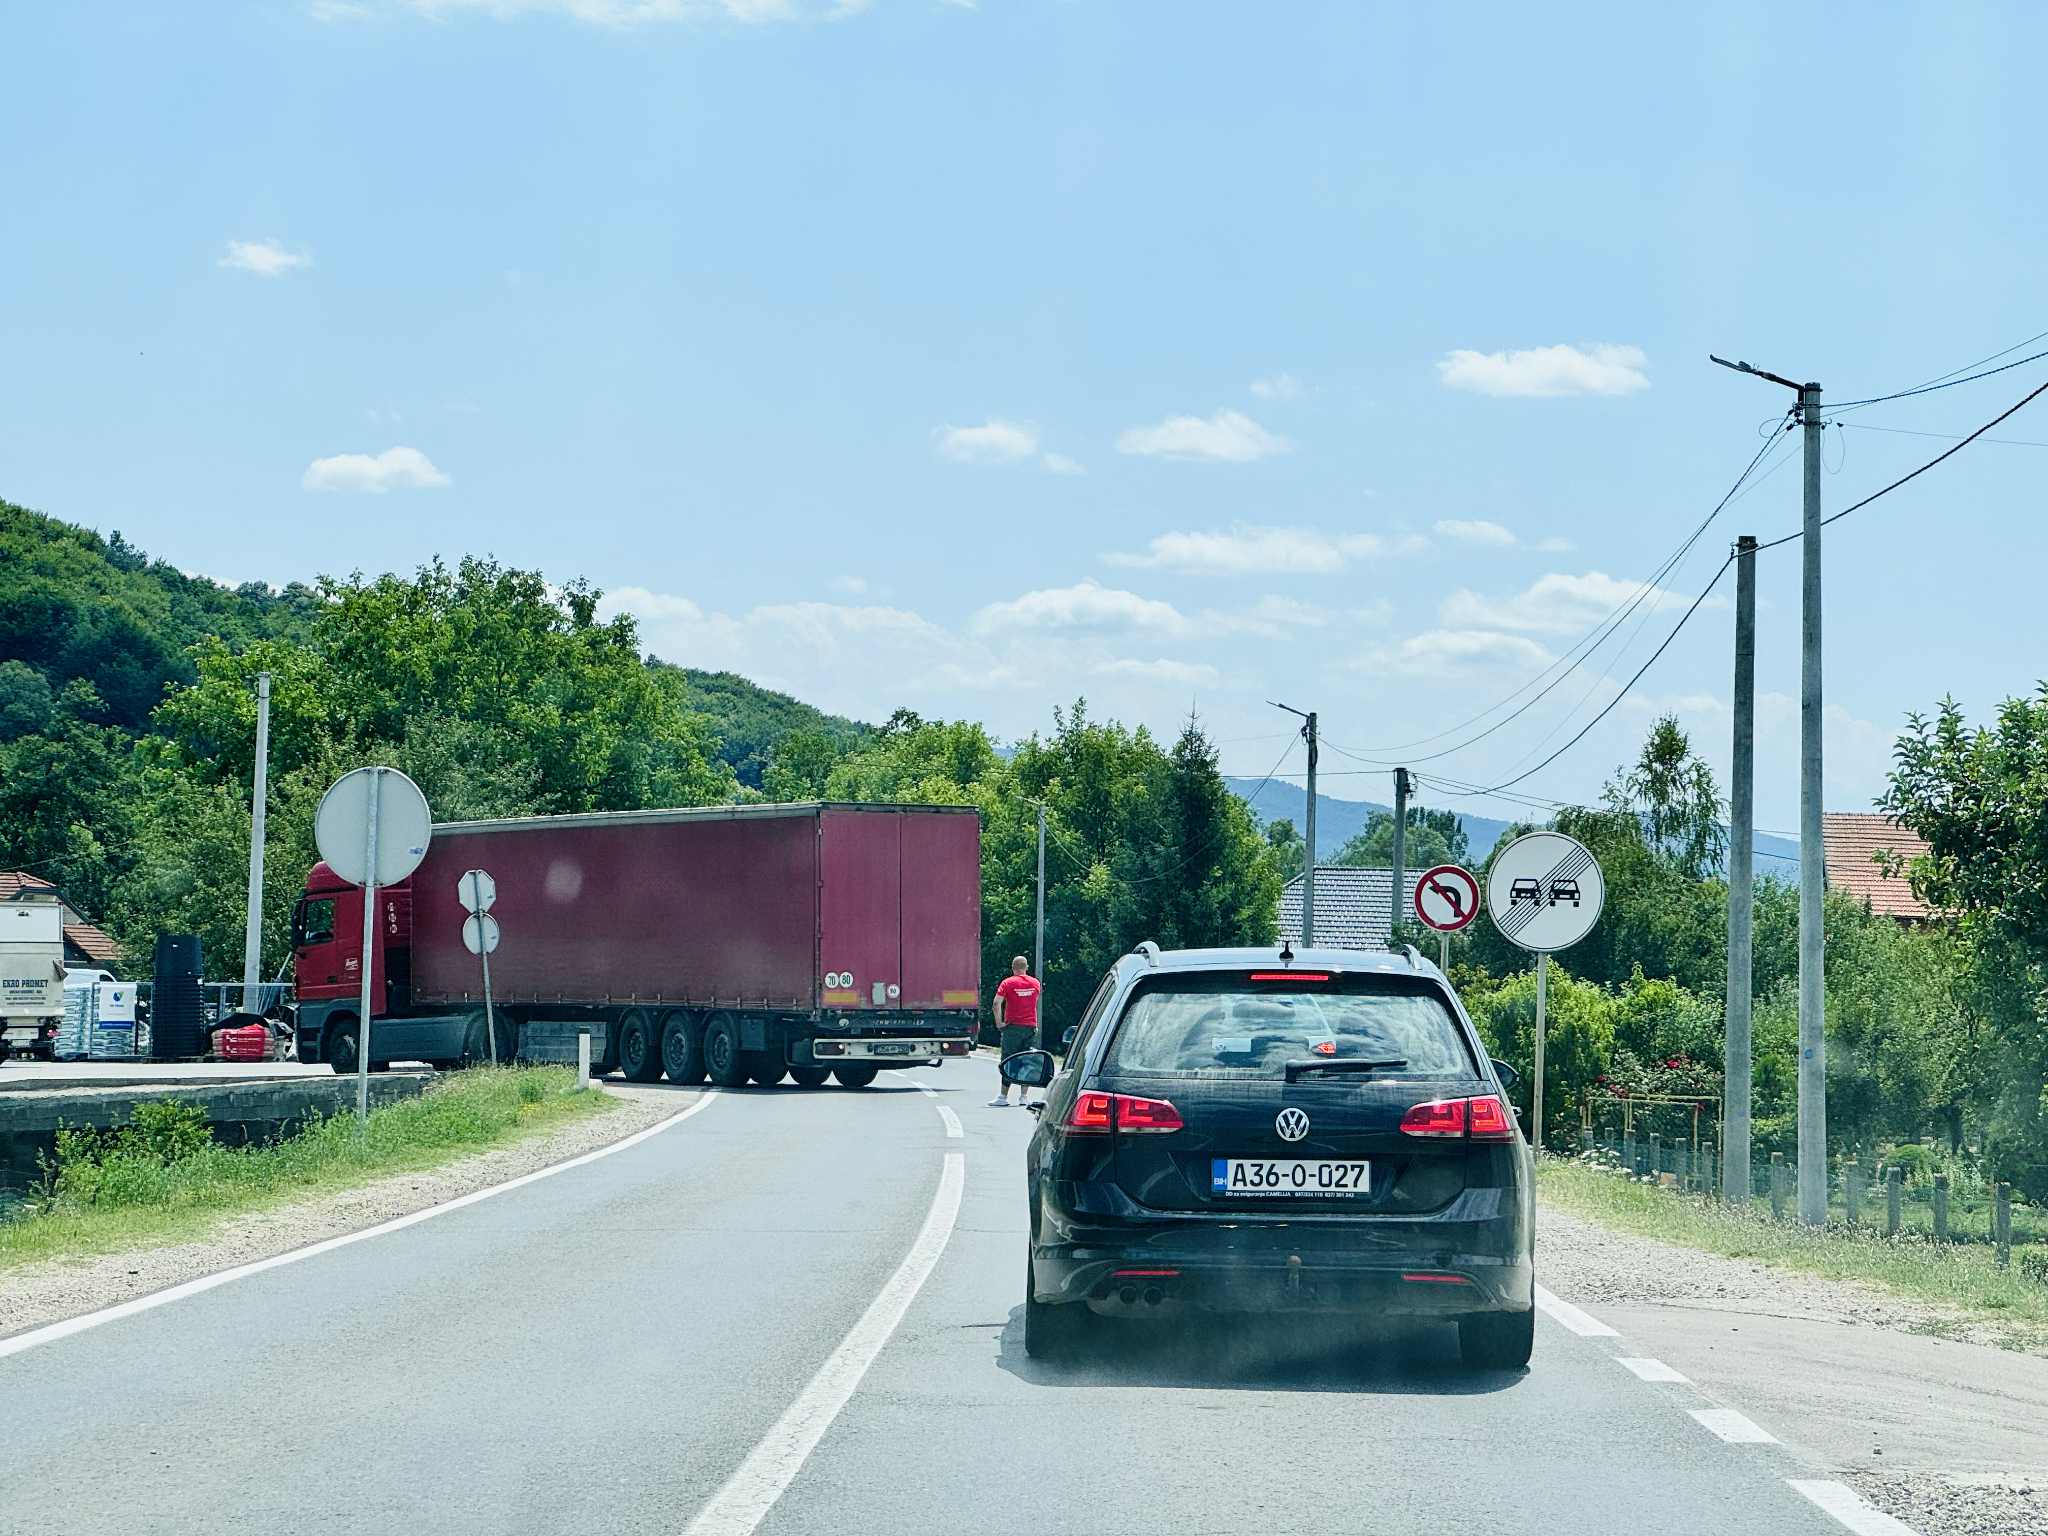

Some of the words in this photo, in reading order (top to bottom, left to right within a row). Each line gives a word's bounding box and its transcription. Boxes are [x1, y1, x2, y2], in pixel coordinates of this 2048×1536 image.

[21, 980, 49, 988] PROMET
[828, 976, 836, 986] 70
[842, 975, 851, 985] 80
[1276, 1108, 1310, 1142] VW
[1214, 1178, 1228, 1186] BIH
